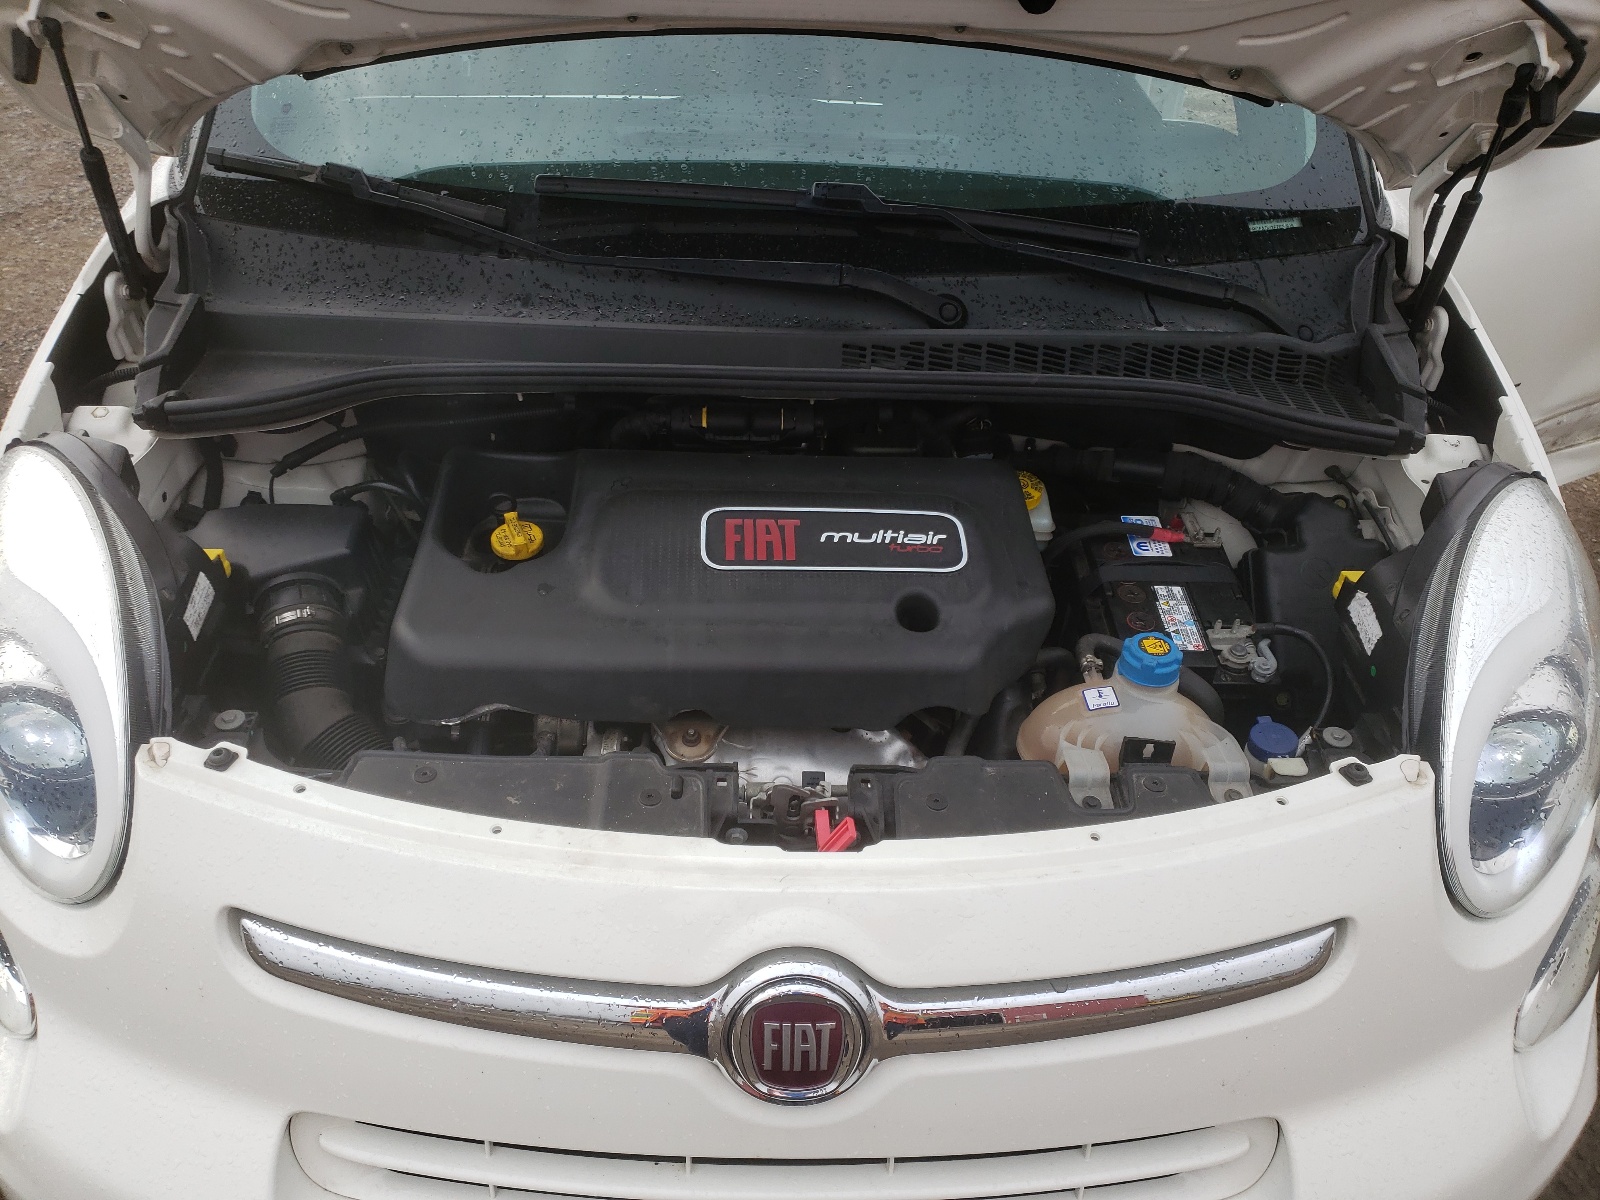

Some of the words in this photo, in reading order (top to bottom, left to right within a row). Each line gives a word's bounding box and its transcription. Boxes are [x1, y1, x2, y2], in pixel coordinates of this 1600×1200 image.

[724, 518, 801, 561] FIAT
[819, 529, 948, 545] multiair
[889, 543, 944, 553] turbo
[763, 1022, 836, 1072] FIAT
